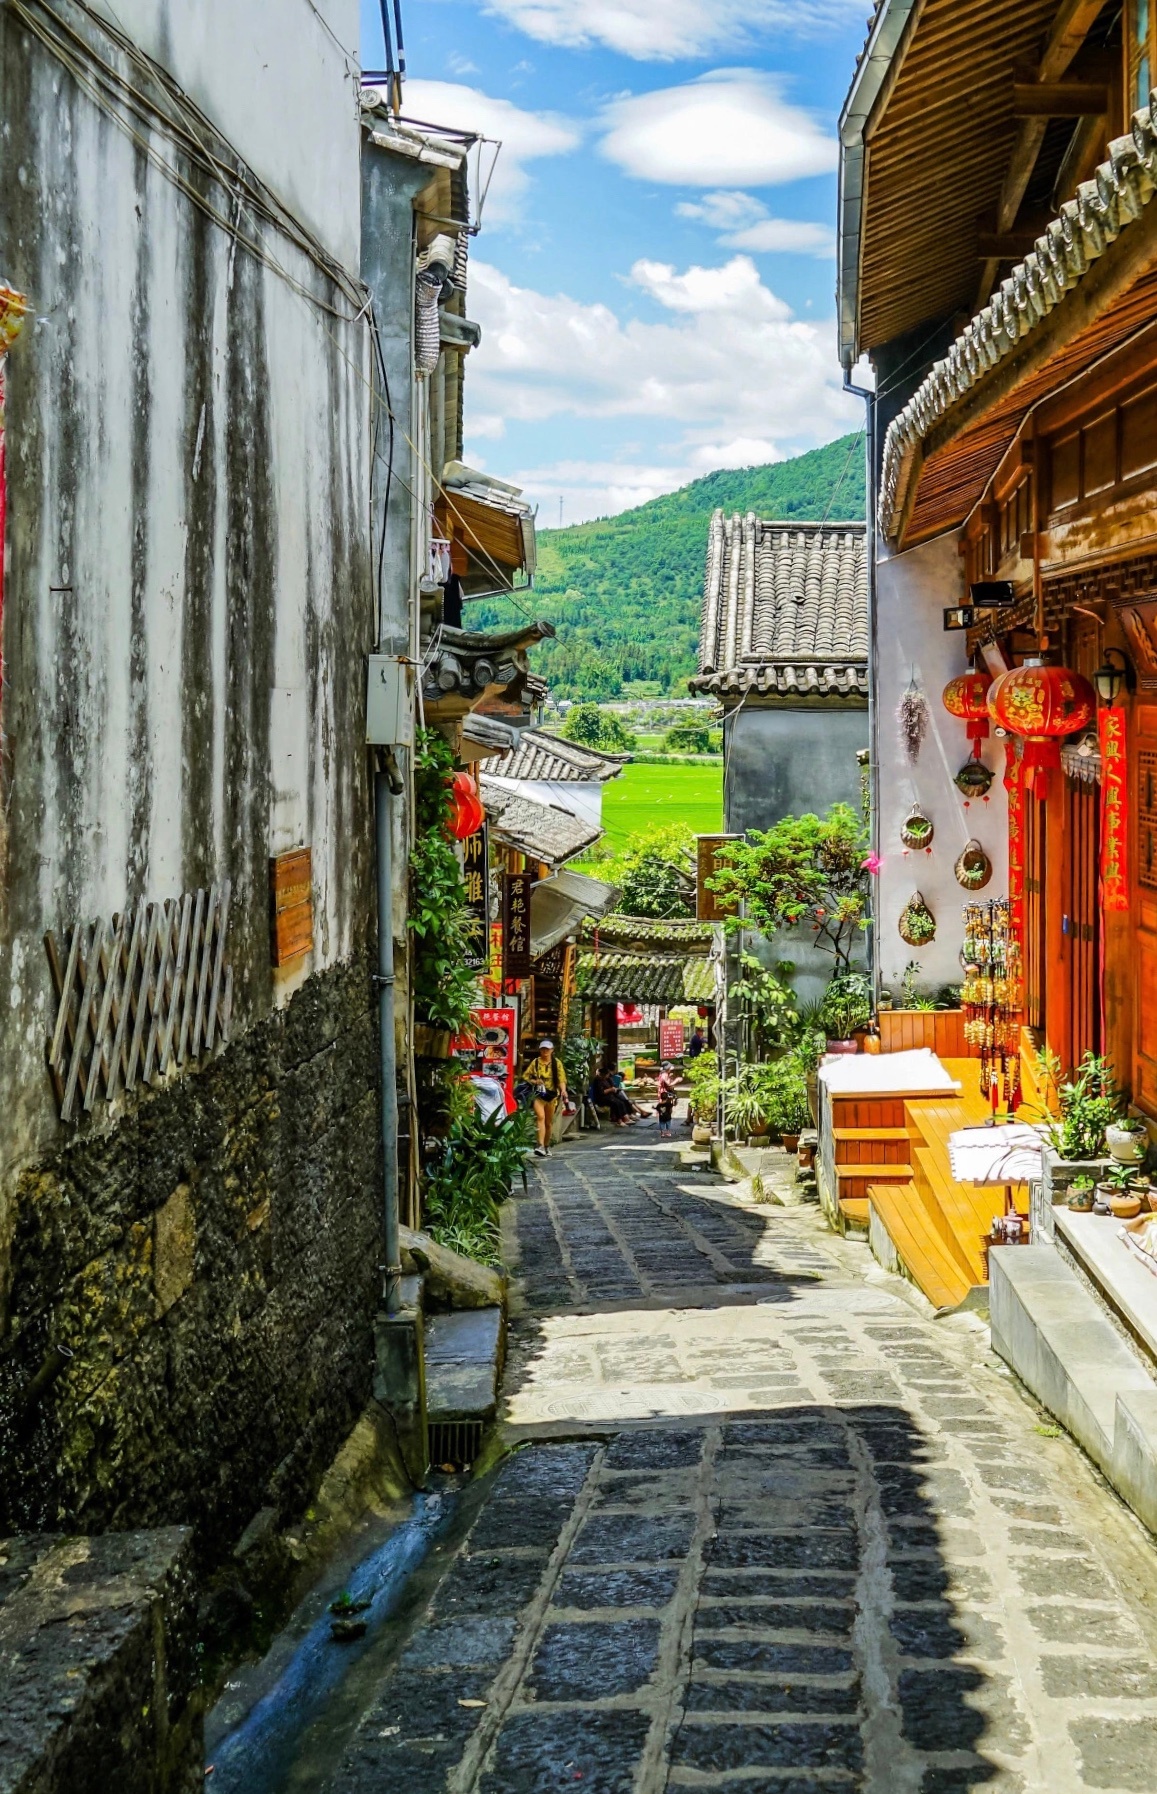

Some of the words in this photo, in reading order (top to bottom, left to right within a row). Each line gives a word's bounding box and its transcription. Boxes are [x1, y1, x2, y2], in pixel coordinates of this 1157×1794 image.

[509, 878, 527, 952] 君艳餐馆
[476, 1012, 510, 1022] 艳餐馆
